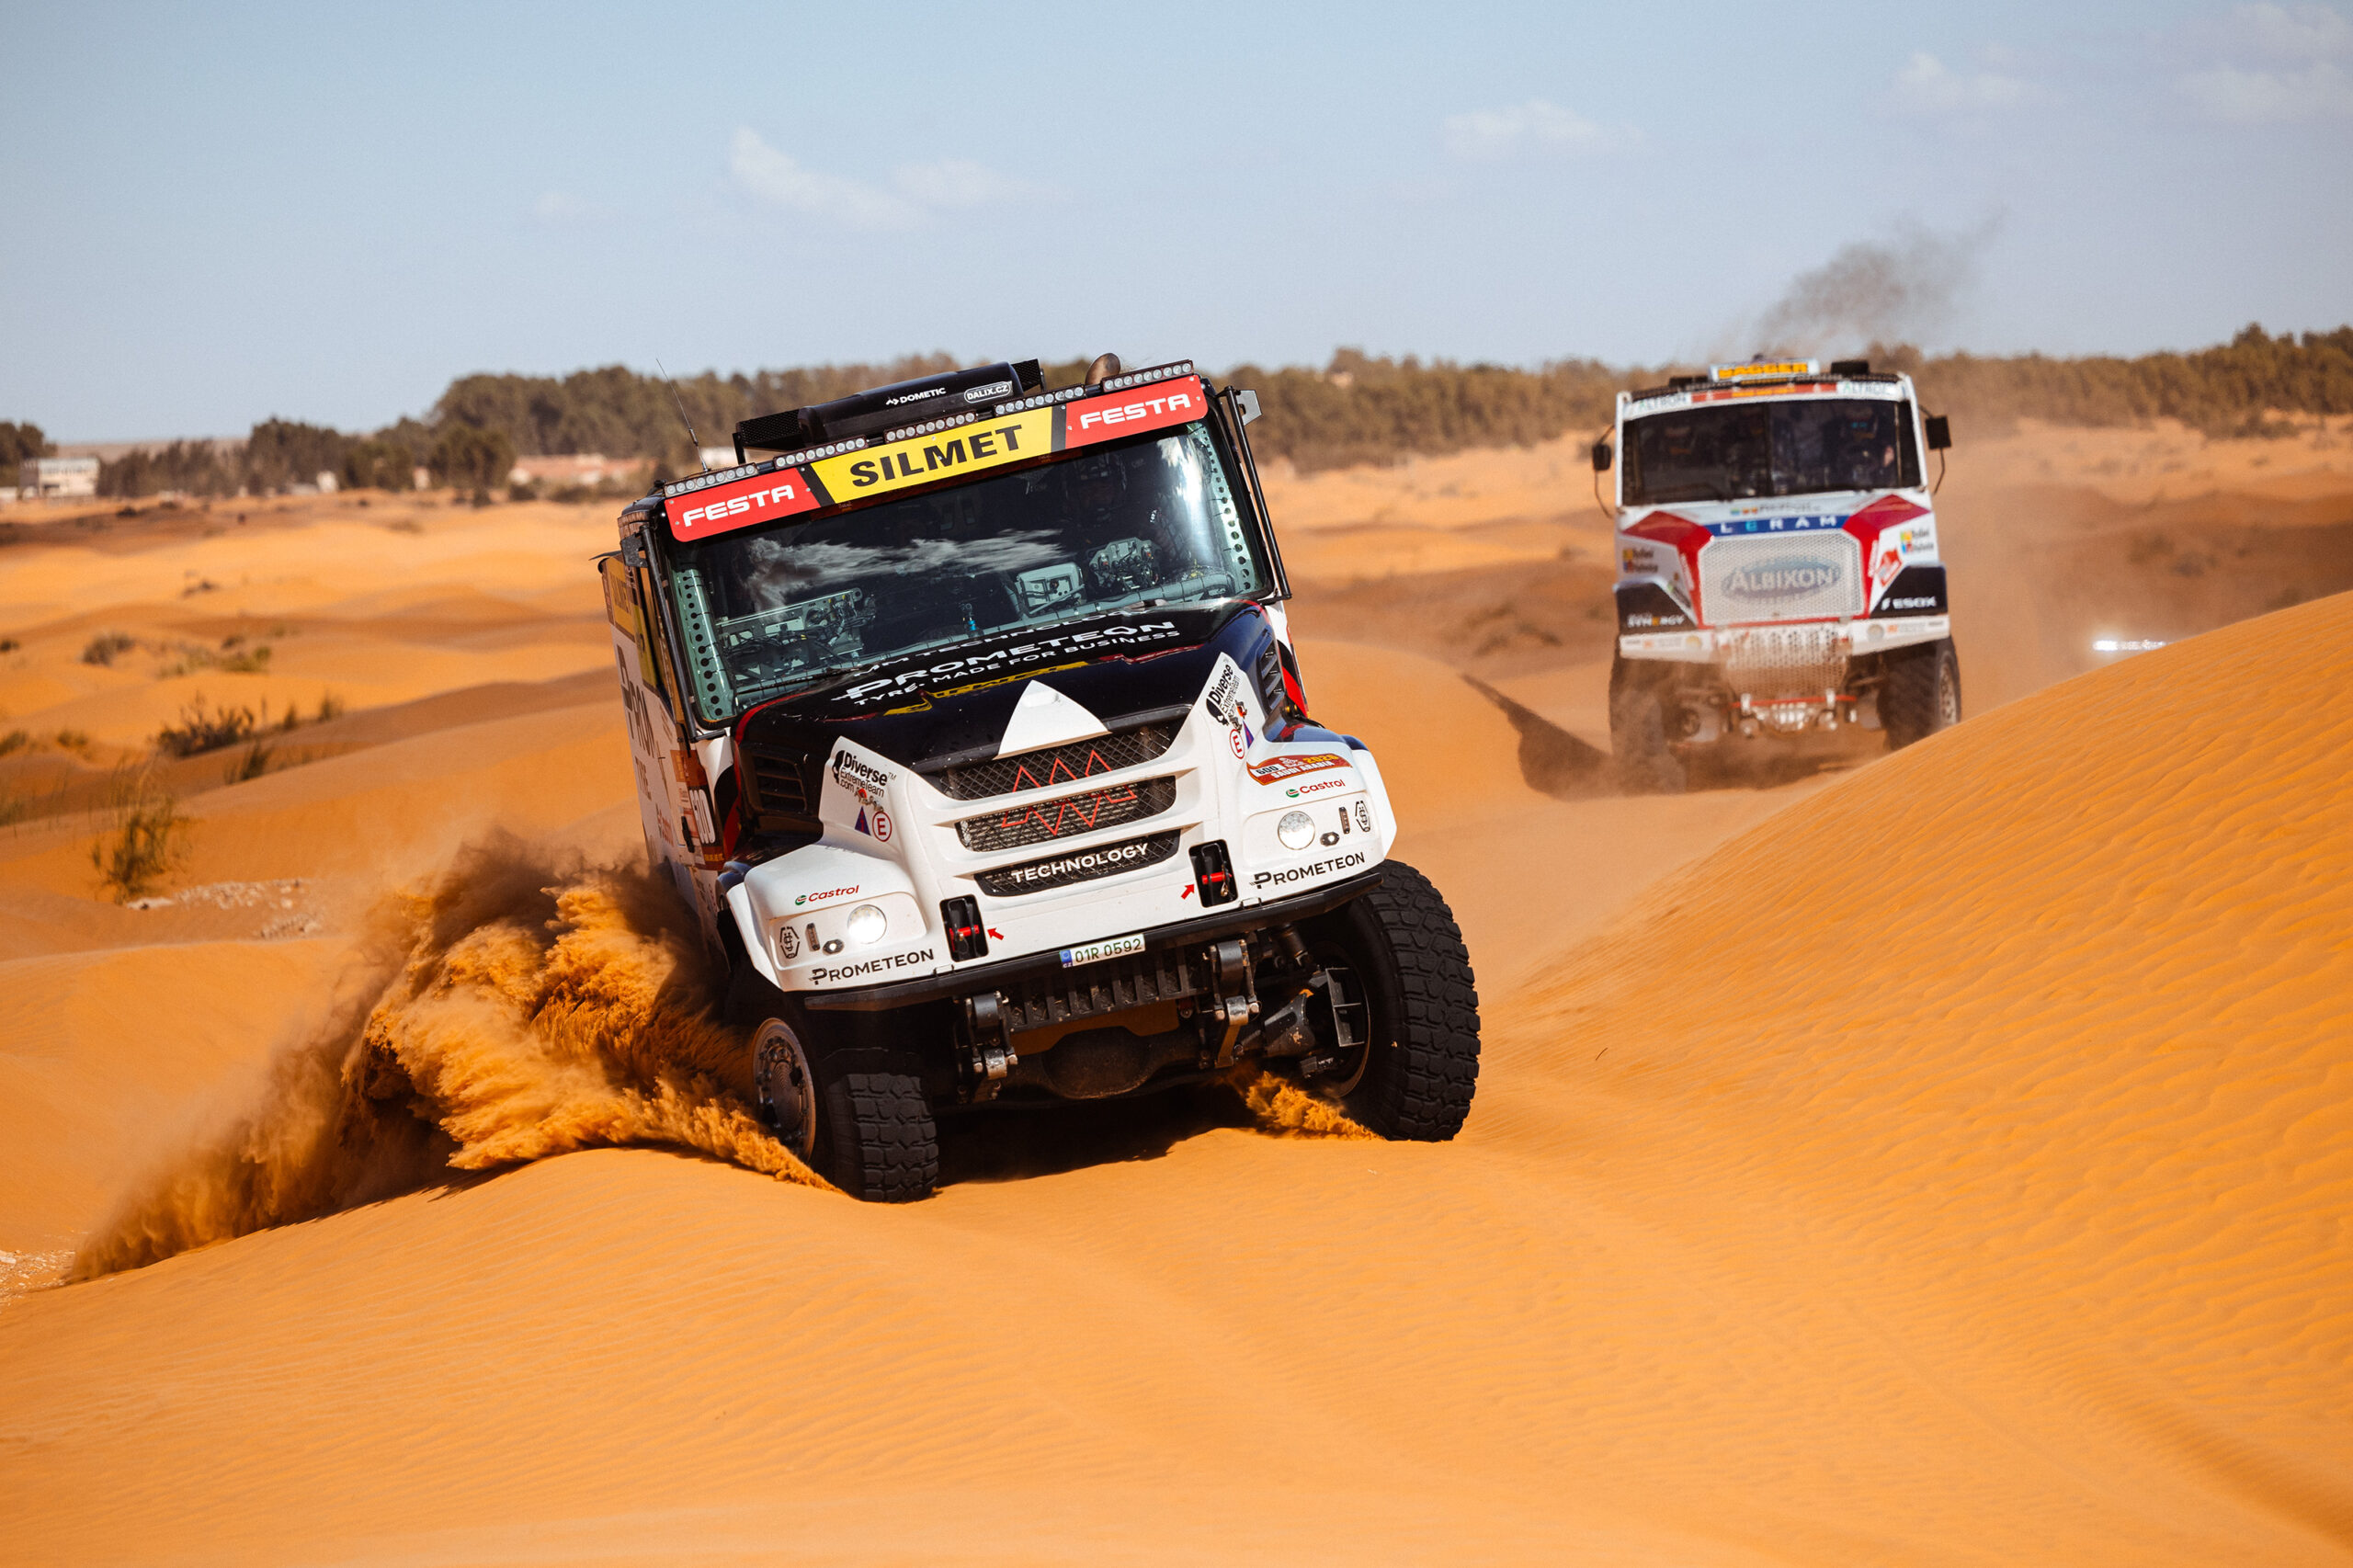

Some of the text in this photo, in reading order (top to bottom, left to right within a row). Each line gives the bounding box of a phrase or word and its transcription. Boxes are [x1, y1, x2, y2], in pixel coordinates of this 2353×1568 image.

[899, 387, 947, 404] DOMETIC
[967, 384, 1008, 400] DALIX.CZ
[1080, 393, 1191, 429] FESTA
[849, 424, 1022, 487] SILMET
[683, 484, 795, 527] FESTA
[1721, 515, 1836, 533] LERAM
[1728, 568, 1835, 592] ALBIXON
[830, 621, 1176, 701] PROMETEON
[932, 663, 1001, 683] MADE
[1008, 651, 1057, 665] FOR
[1064, 631, 1180, 653] BUSINESS
[1208, 664, 1233, 705] Diverse
[839, 767, 885, 797] ExtremeTeam
[844, 752, 888, 787] Diverse
[1256, 766, 1279, 775] 600
[1271, 767, 1302, 778] SAUDI
[1299, 761, 1335, 771] ARABIA
[1299, 778, 1346, 794] Castrol
[1011, 843, 1148, 882] TECHNOLOGY
[1249, 851, 1365, 889] PROMETEON
[808, 885, 859, 903] Castrol
[1074, 947, 1099, 962] 01R
[1104, 938, 1142, 957] 0592
[809, 949, 934, 985] PROMETEON
